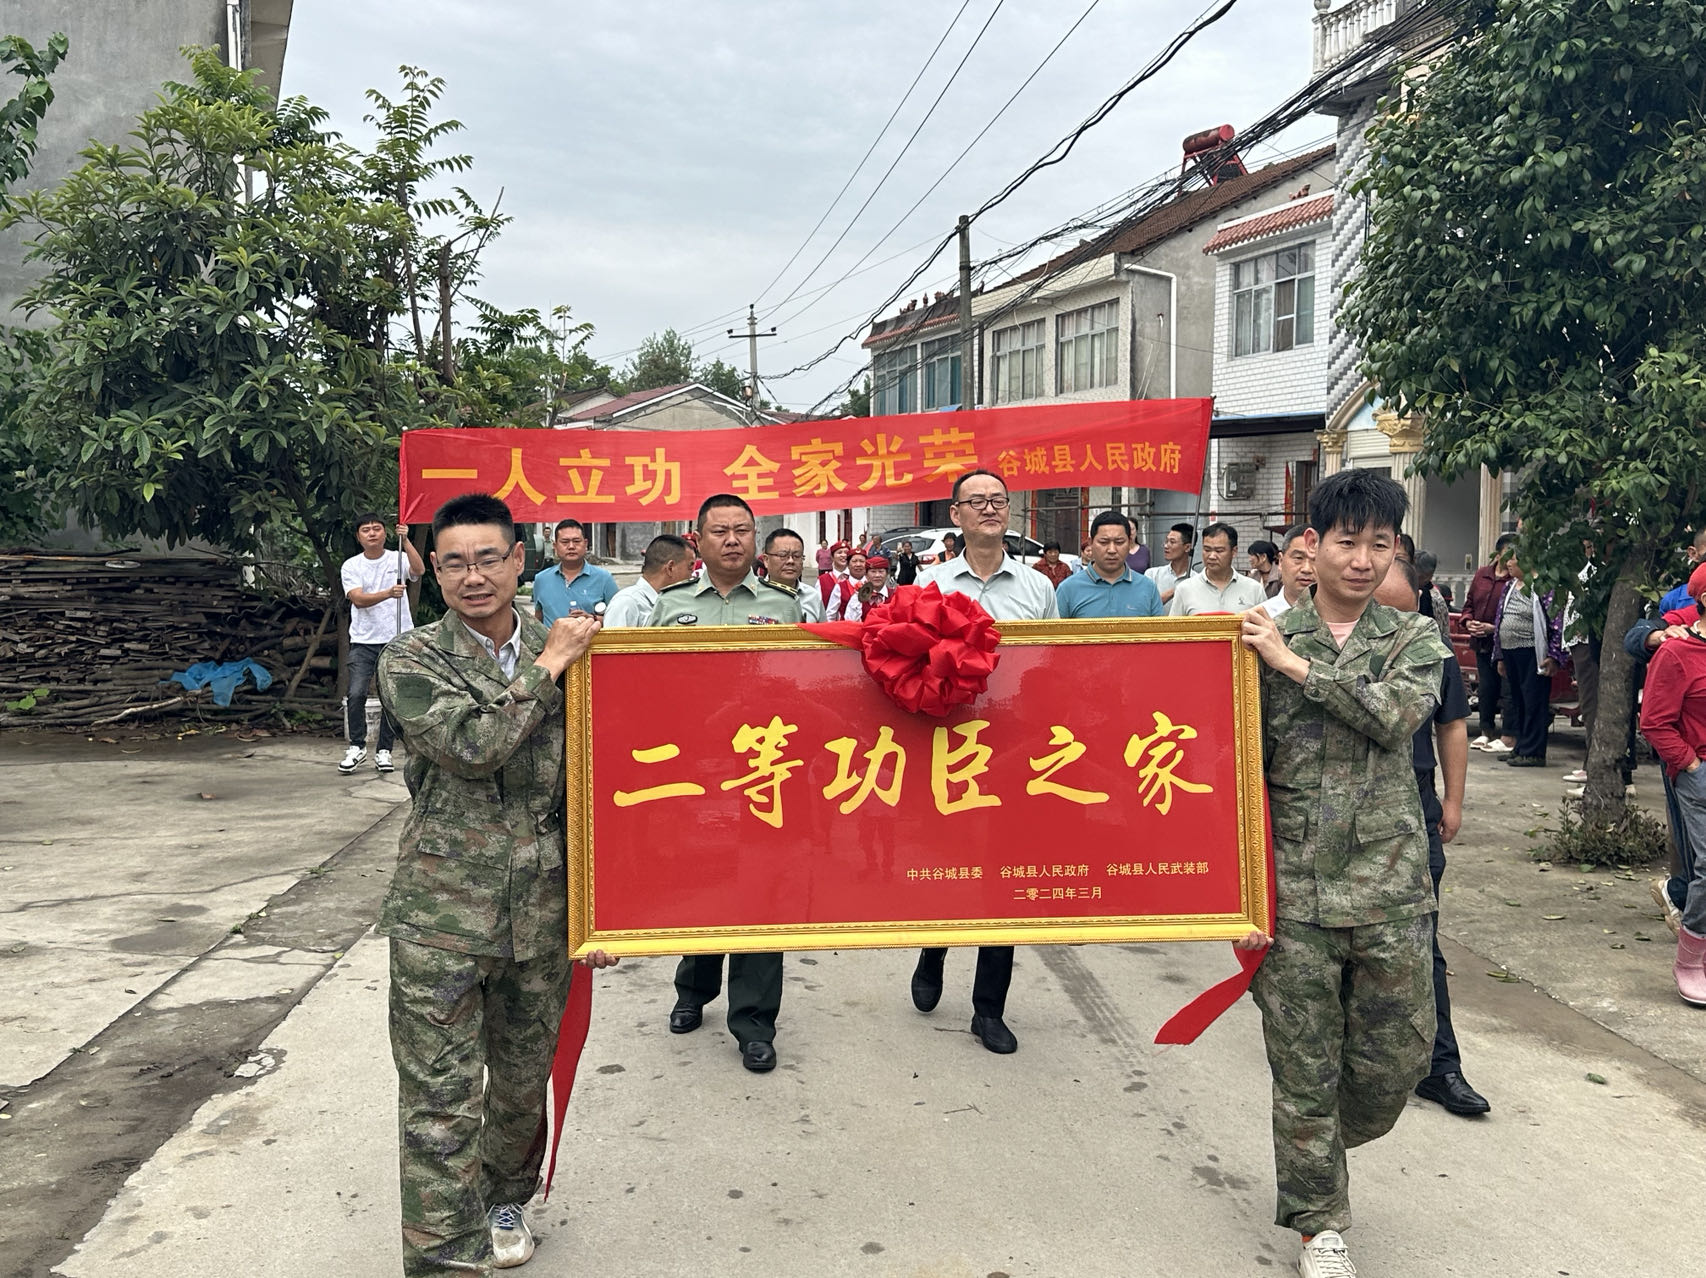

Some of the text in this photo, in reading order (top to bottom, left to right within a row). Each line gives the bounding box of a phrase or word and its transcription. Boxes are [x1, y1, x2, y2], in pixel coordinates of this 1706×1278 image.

[421, 427, 979, 506] 一人立功 全家光荣
[998, 442, 1182, 477] 谷城县人民政府
[613, 711, 1213, 829] 二等功臣之家
[906, 861, 1209, 880] 中共谷城县委 谷城县人民政府 谷城县人民武装部
[1013, 886, 1103, 901] 二零二四年三月
